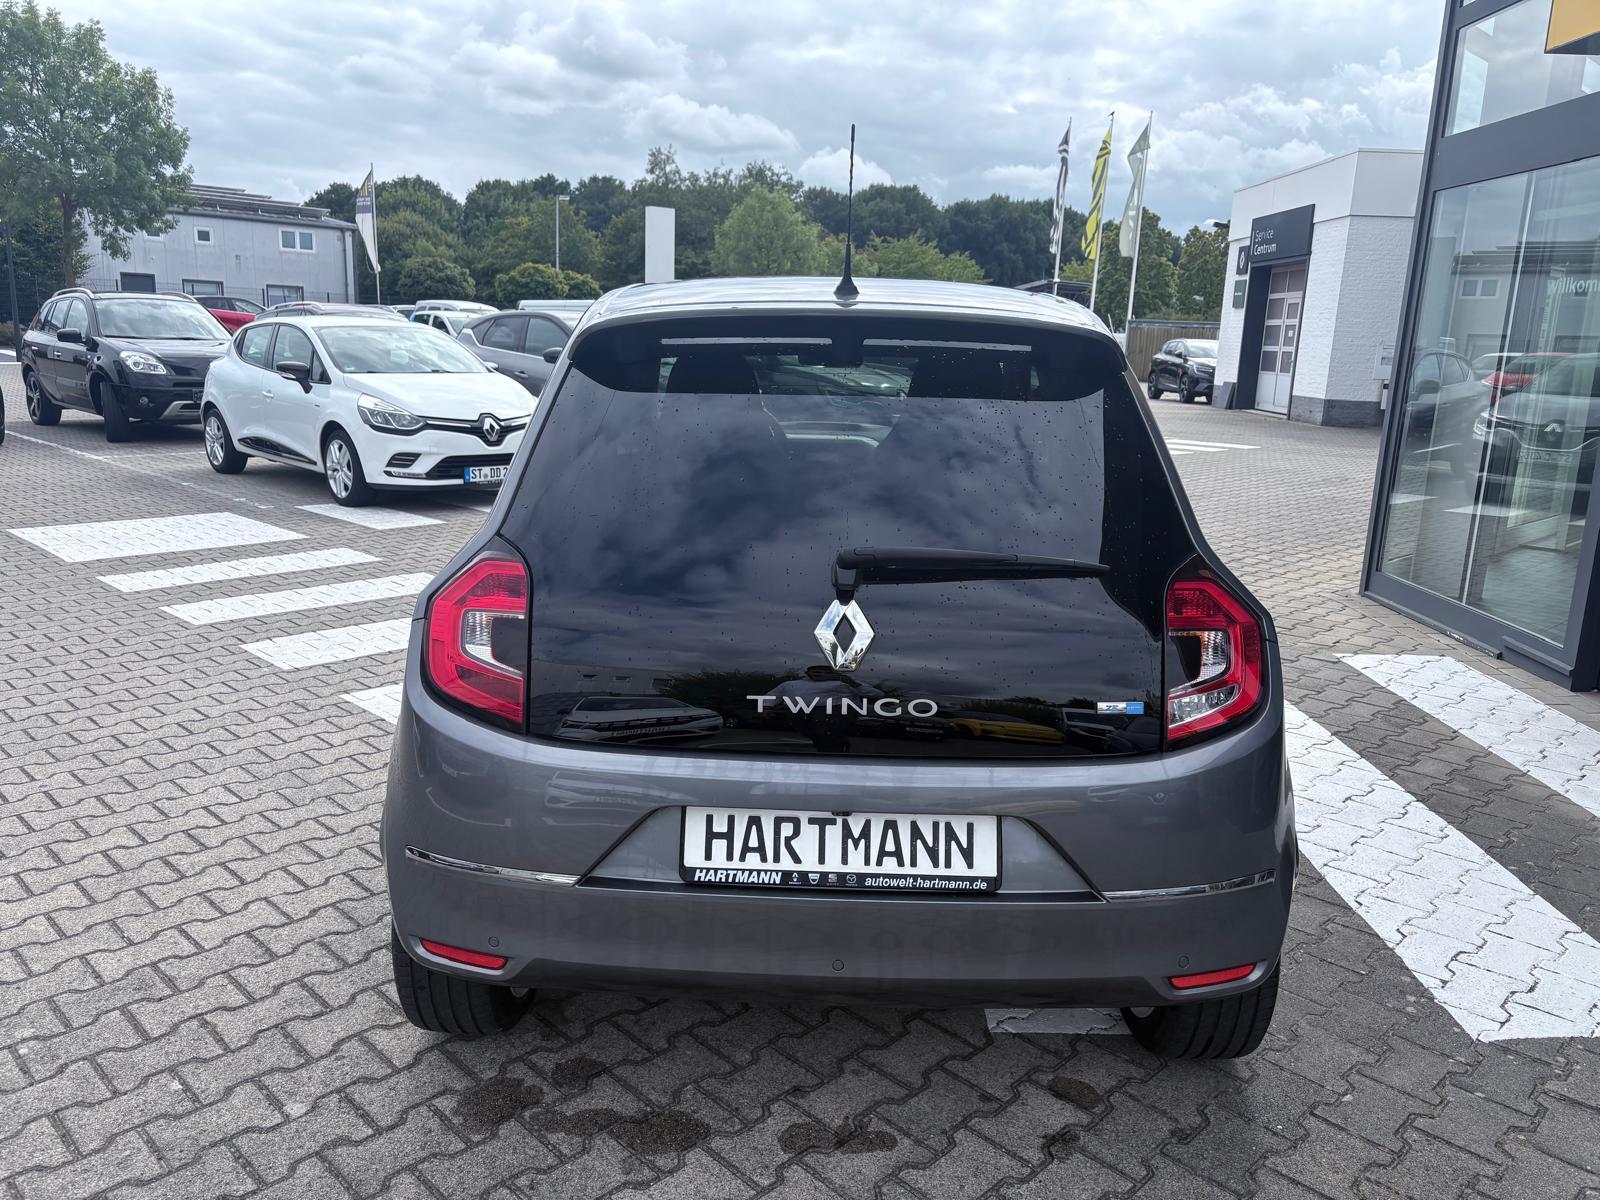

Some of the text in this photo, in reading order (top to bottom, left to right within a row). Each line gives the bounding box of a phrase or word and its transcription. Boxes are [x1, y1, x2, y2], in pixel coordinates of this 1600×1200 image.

[1255, 229, 1274, 242] Service
[1253, 243, 1277, 256] Centrum
[1547, 276, 1600, 295] willkom
[471, 468, 483, 480] ST
[490, 467, 502, 478] DD
[746, 695, 938, 718] TWINGO
[703, 813, 975, 870] HARTMANN
[693, 868, 988, 891] HARTMANN autowelt-hartmann.de
